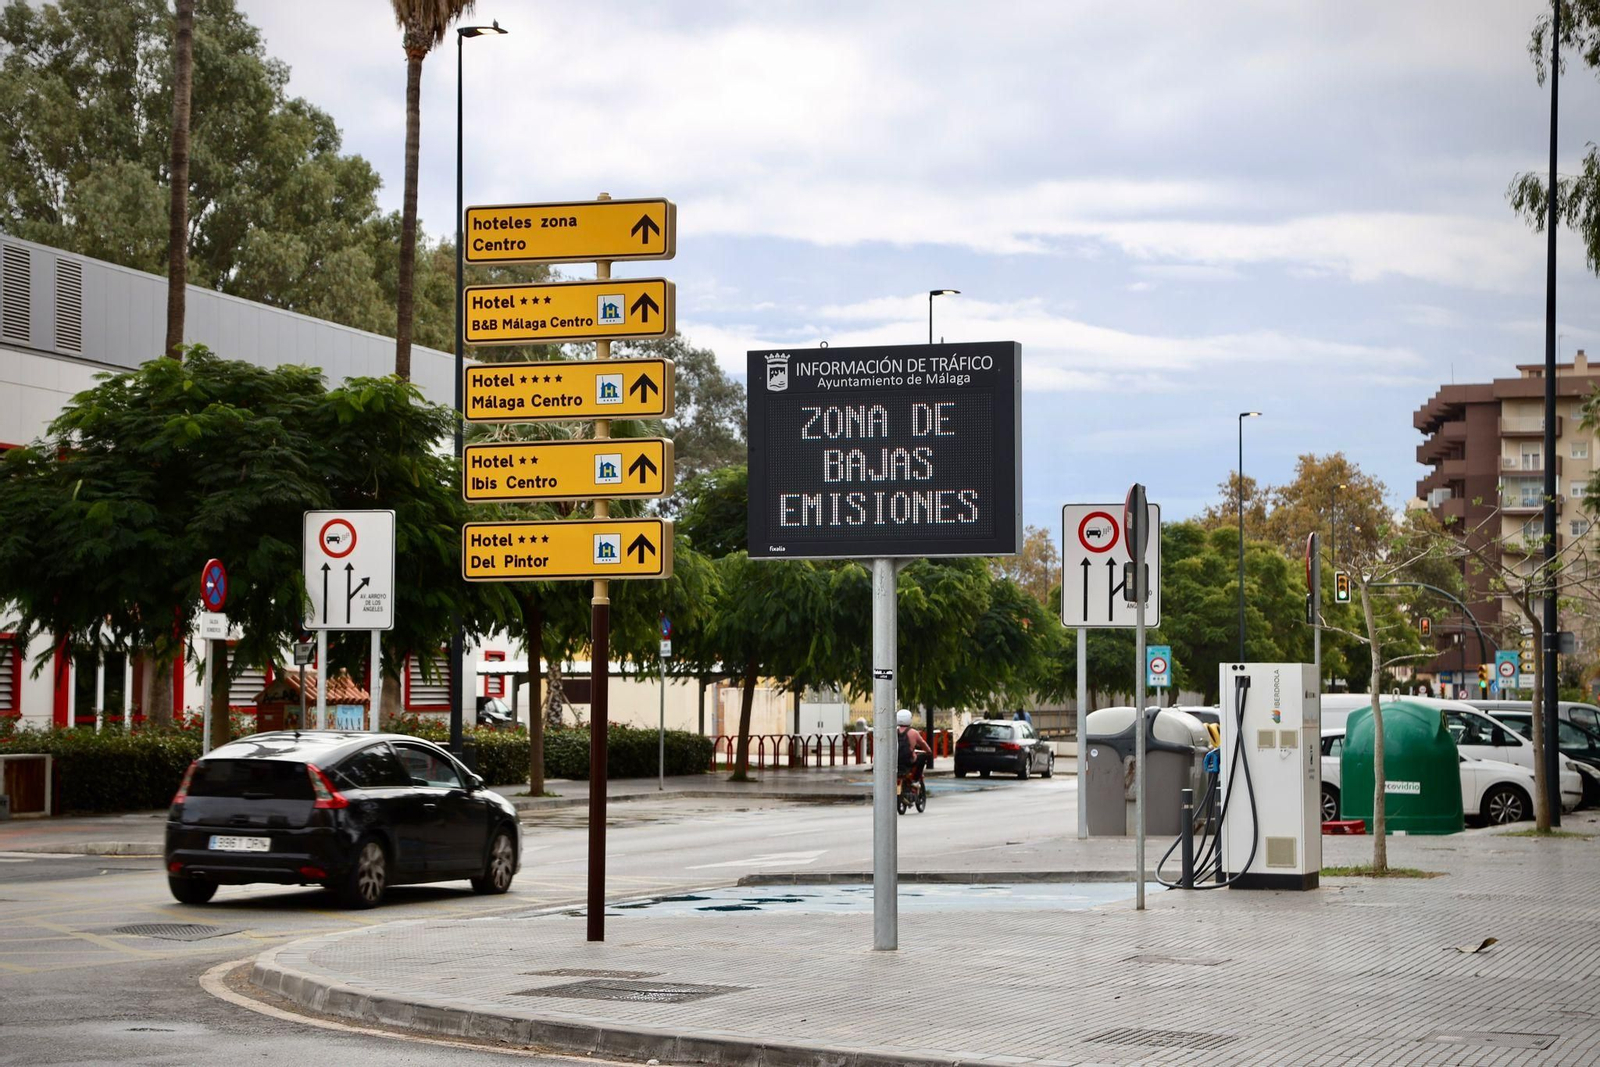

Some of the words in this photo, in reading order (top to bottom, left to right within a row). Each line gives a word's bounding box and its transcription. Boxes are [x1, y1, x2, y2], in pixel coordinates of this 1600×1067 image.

[473, 216, 532, 230] hoteles
[540, 216, 577, 228] zona
[473, 238, 526, 252] Centro
[472, 295, 515, 309] Hotel
[472, 319, 498, 331] B&B
[502, 317, 547, 331] Málaga
[550, 316, 593, 328] Centro
[796, 356, 903, 377] INFORMACIÓN
[907, 358, 926, 373] DE
[929, 353, 993, 372] TRÁFICO
[472, 373, 514, 388] Hotel
[817, 376, 903, 389] Ayuntamiento
[906, 374, 922, 385] de
[926, 372, 971, 386] Málaga
[472, 395, 525, 411] Málaga
[531, 393, 583, 407] Centro
[801, 404, 888, 440] ZONA
[912, 402, 955, 437] DE
[471, 454, 514, 468] Hotel
[824, 447, 933, 483] BAJAS
[471, 476, 497, 490] Ibis
[506, 475, 557, 489] Centro
[780, 489, 978, 527] EMISIONES
[471, 533, 513, 547] Hotel
[471, 554, 495, 569] Del
[504, 553, 549, 568] Pintor
[1273, 669, 1281, 708] IBERDROLA
[1385, 782, 1420, 791] covidrio
